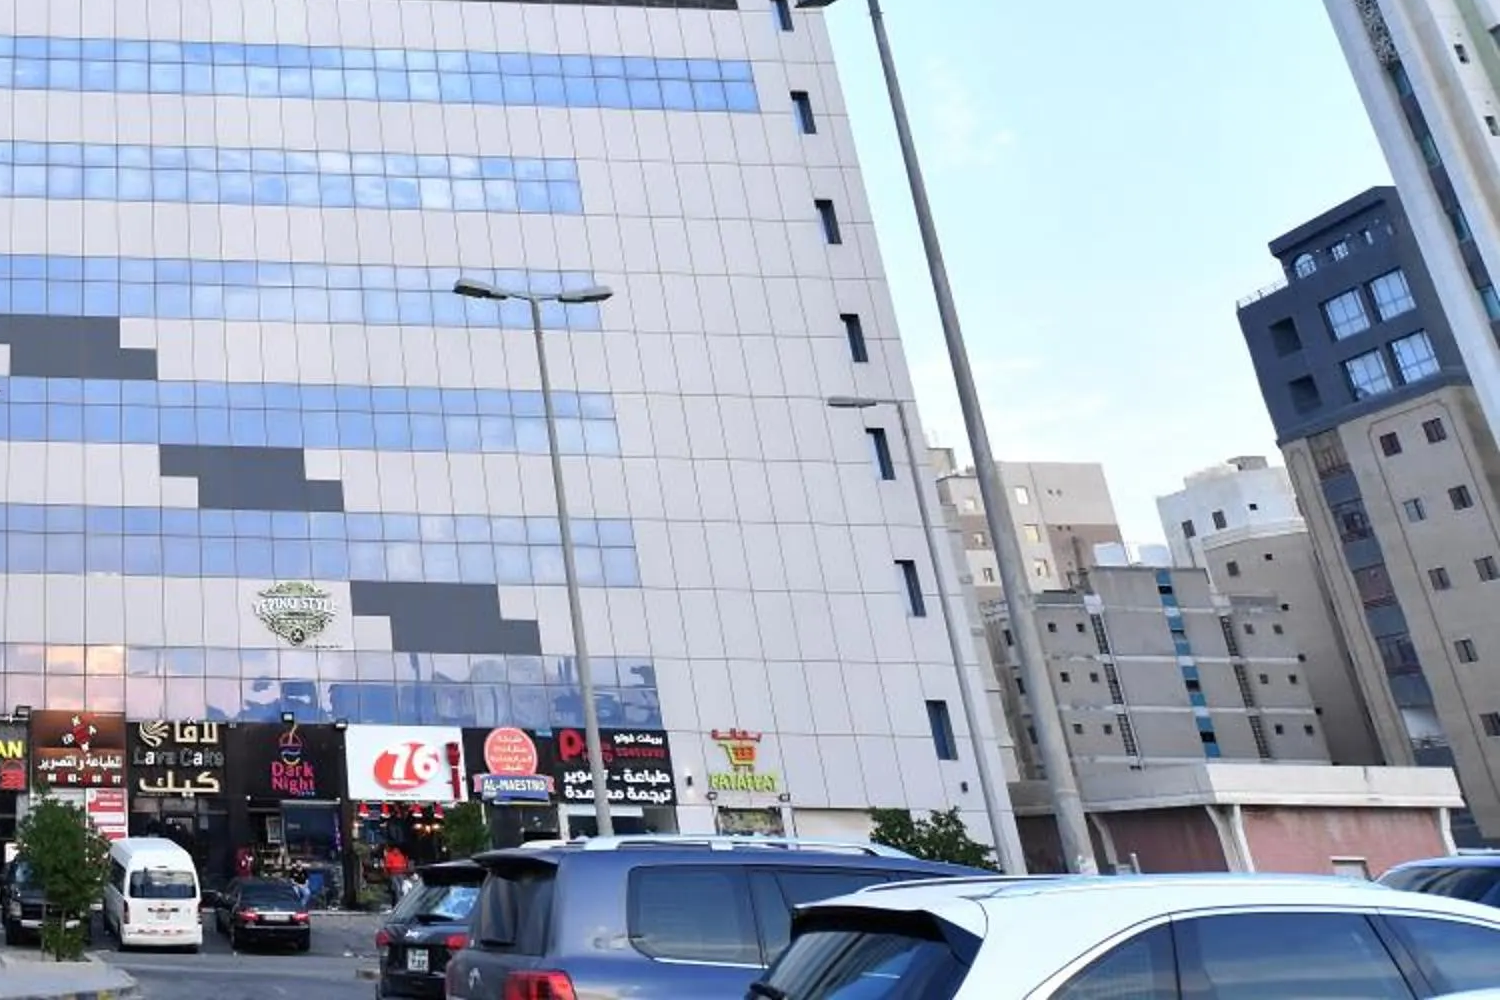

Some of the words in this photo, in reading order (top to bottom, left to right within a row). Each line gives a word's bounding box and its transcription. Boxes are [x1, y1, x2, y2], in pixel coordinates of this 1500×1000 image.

[271, 761, 314, 777] Dark
[563, 769, 609, 784] توير
[623, 769, 671, 785] طباعة
[271, 777, 316, 796] Night
